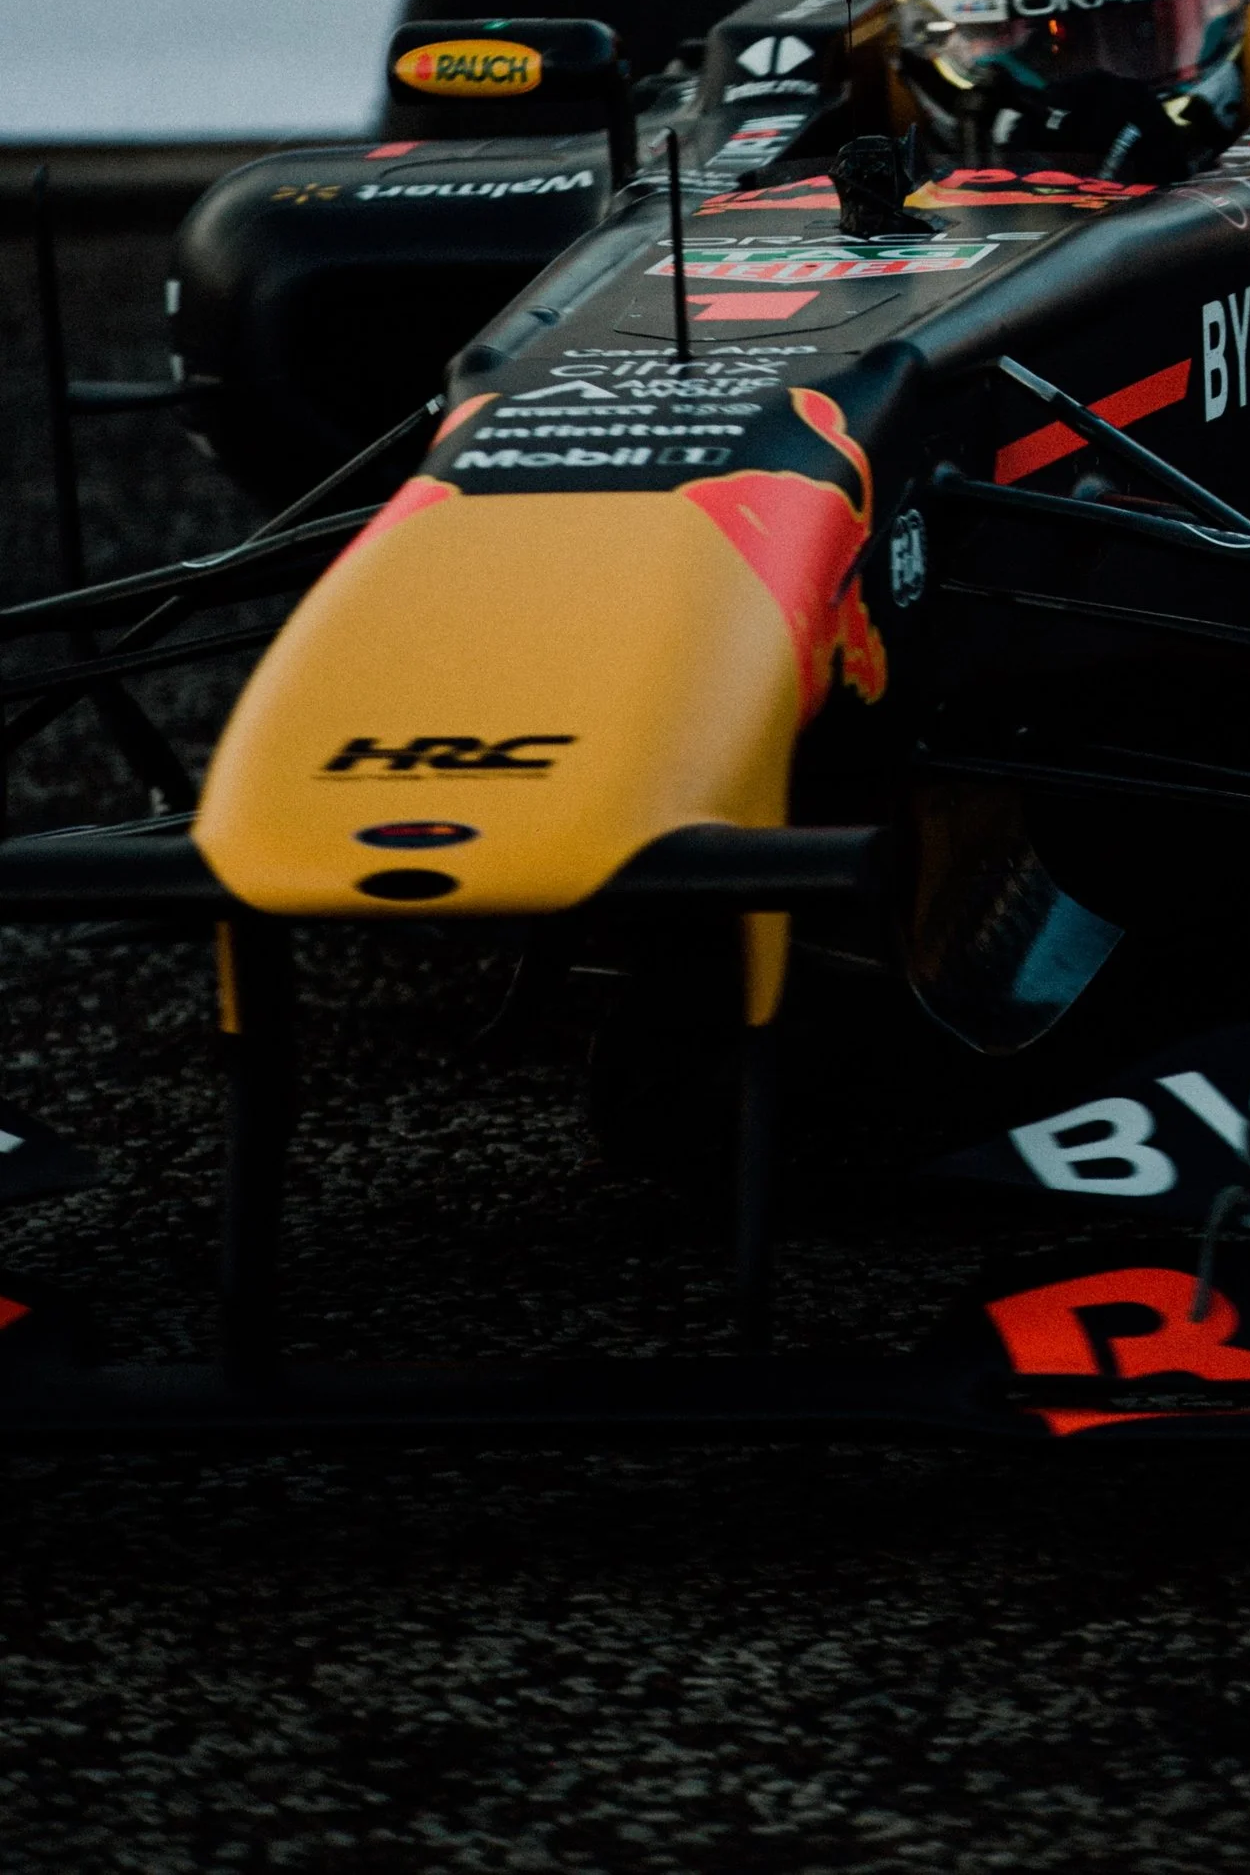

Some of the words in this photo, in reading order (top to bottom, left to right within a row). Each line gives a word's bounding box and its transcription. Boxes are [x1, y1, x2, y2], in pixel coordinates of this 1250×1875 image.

[435, 53, 530, 85] RAUCH
[353, 168, 596, 202] Walmart
[656, 230, 1050, 247] ORACLE
[700, 244, 957, 263] TAG
[549, 357, 789, 377] citrix
[452, 447, 654, 470] Mobil
[325, 735, 578, 772] HRC
